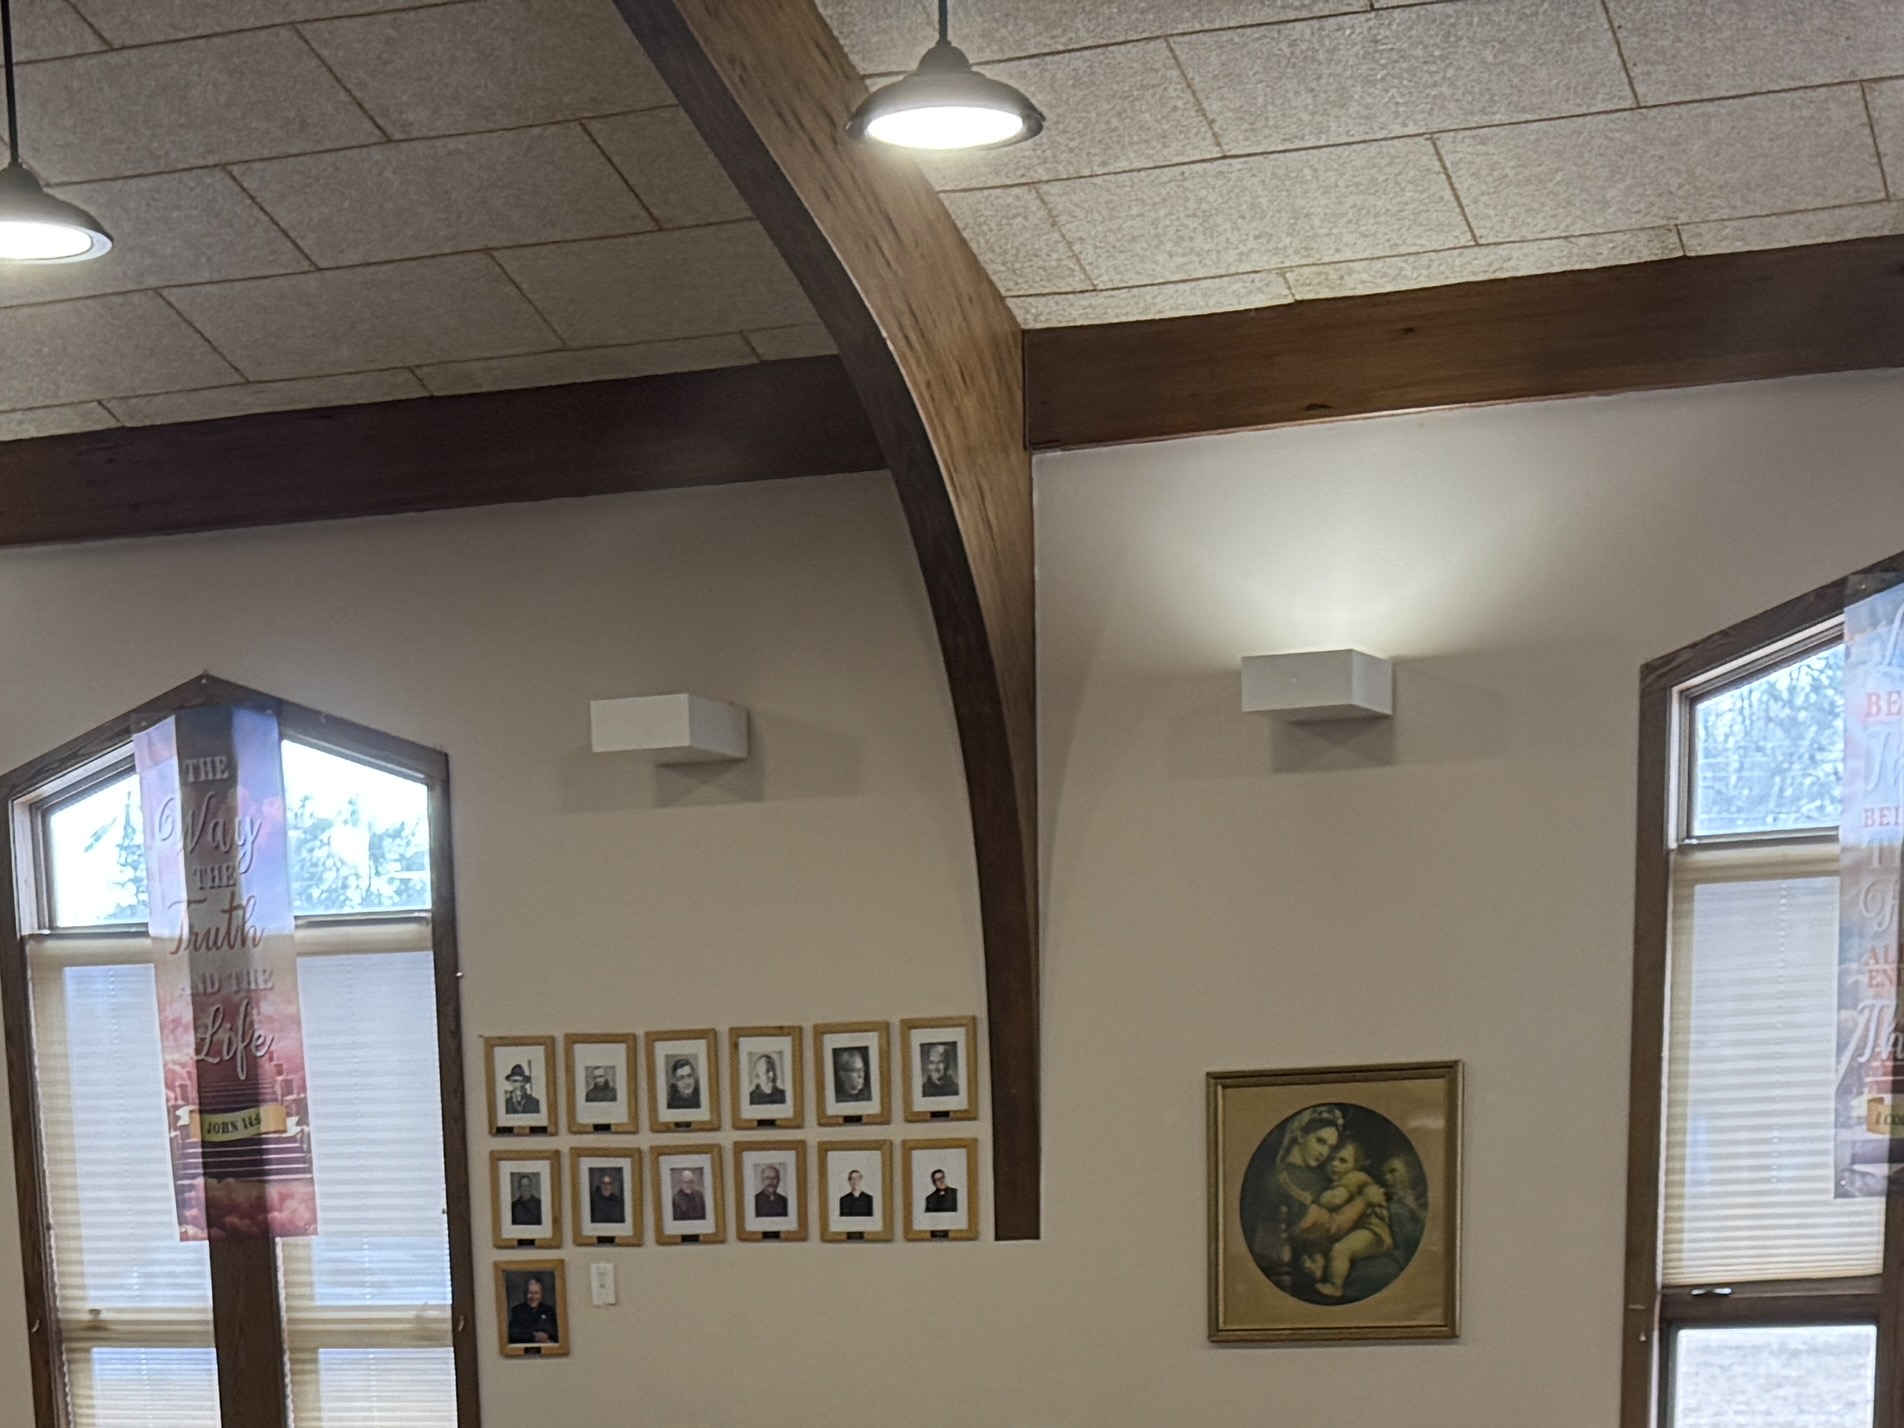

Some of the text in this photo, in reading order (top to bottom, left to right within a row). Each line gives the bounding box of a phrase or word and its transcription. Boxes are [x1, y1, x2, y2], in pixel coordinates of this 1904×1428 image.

[184, 756, 229, 783] THE
[156, 794, 263, 876] Way
[193, 865, 236, 890] THE
[167, 894, 265, 956] Truth
[178, 967, 274, 998] AND THE
[196, 1001, 275, 1079] Life
[206, 1119, 239, 1135] JOHN
